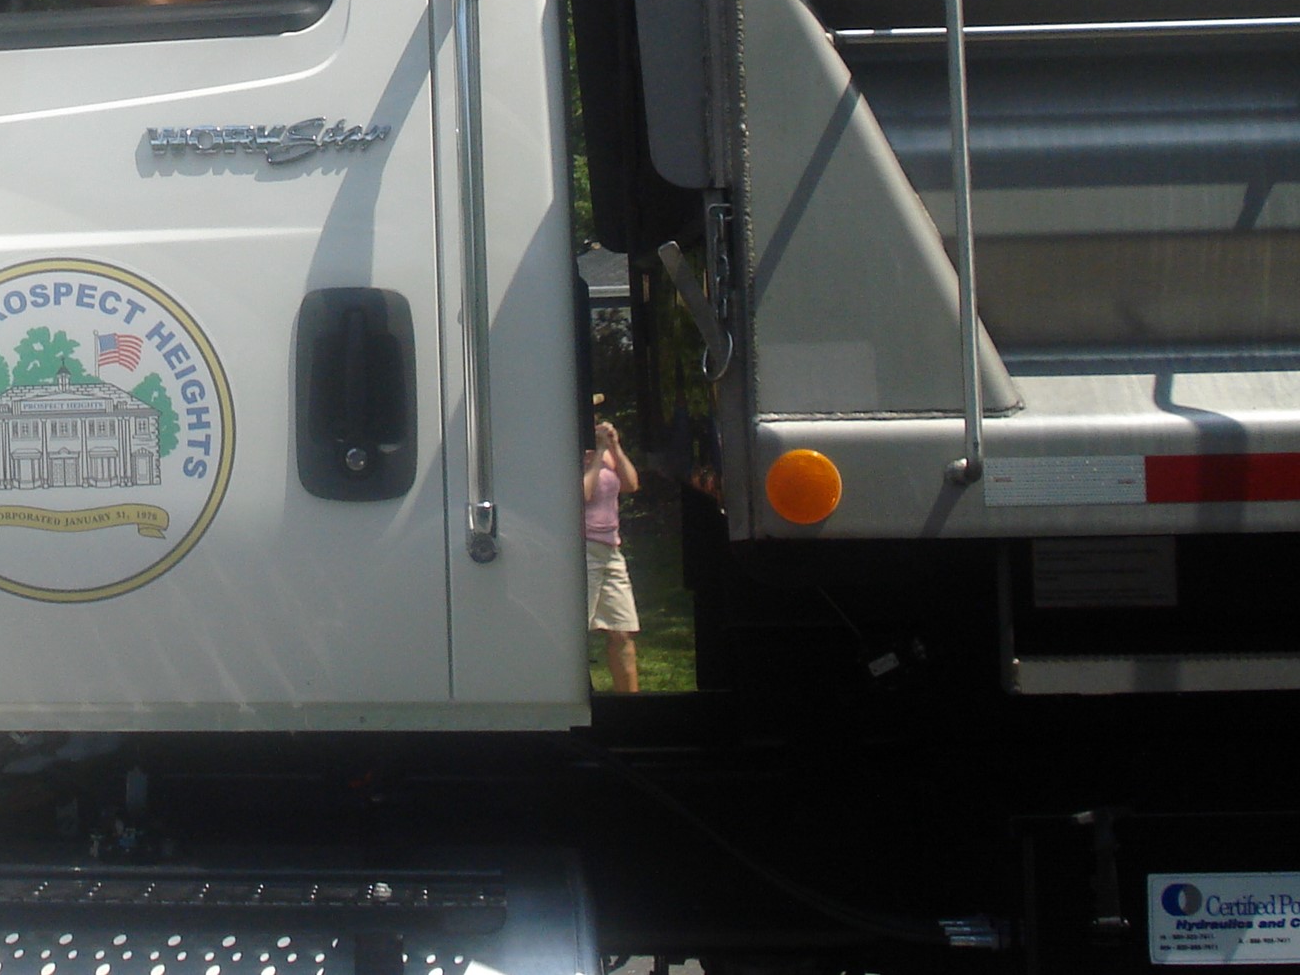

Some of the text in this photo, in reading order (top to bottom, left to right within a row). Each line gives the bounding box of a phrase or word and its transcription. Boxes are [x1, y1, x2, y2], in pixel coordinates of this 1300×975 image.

[23, 401, 103, 411] PROSPECT HEIGHTS
[145, 321, 212, 480] HEIGHTS
[65, 512, 111, 526] JANUARY
[1206, 894, 1275, 916] Certified
[1176, 919, 1253, 931] Hydraulics
[1258, 917, 1286, 928] and
